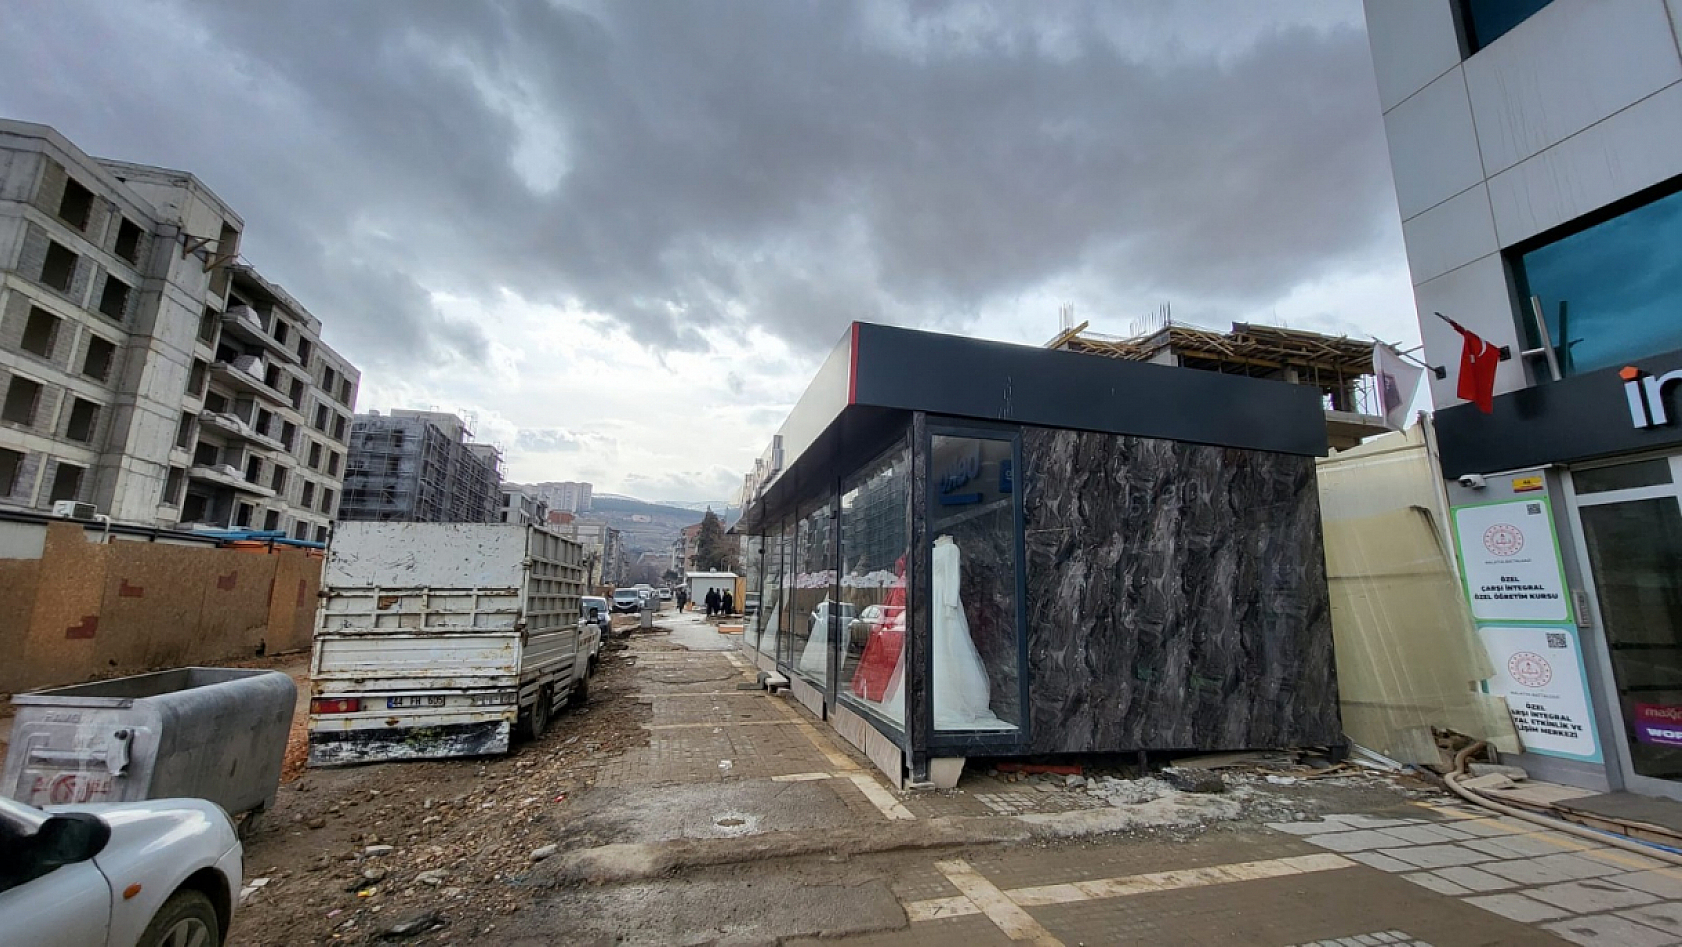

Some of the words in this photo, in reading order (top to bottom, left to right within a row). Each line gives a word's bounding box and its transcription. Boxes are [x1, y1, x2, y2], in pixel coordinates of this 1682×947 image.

[1505, 583, 1545, 591] İNTEGRAL
[1494, 592, 1528, 600] ÖĞRETİM
[1525, 702, 1546, 711] ÖZEL
[1511, 709, 1529, 717] ARŞI
[1530, 710, 1572, 722] İNTEGRAL
